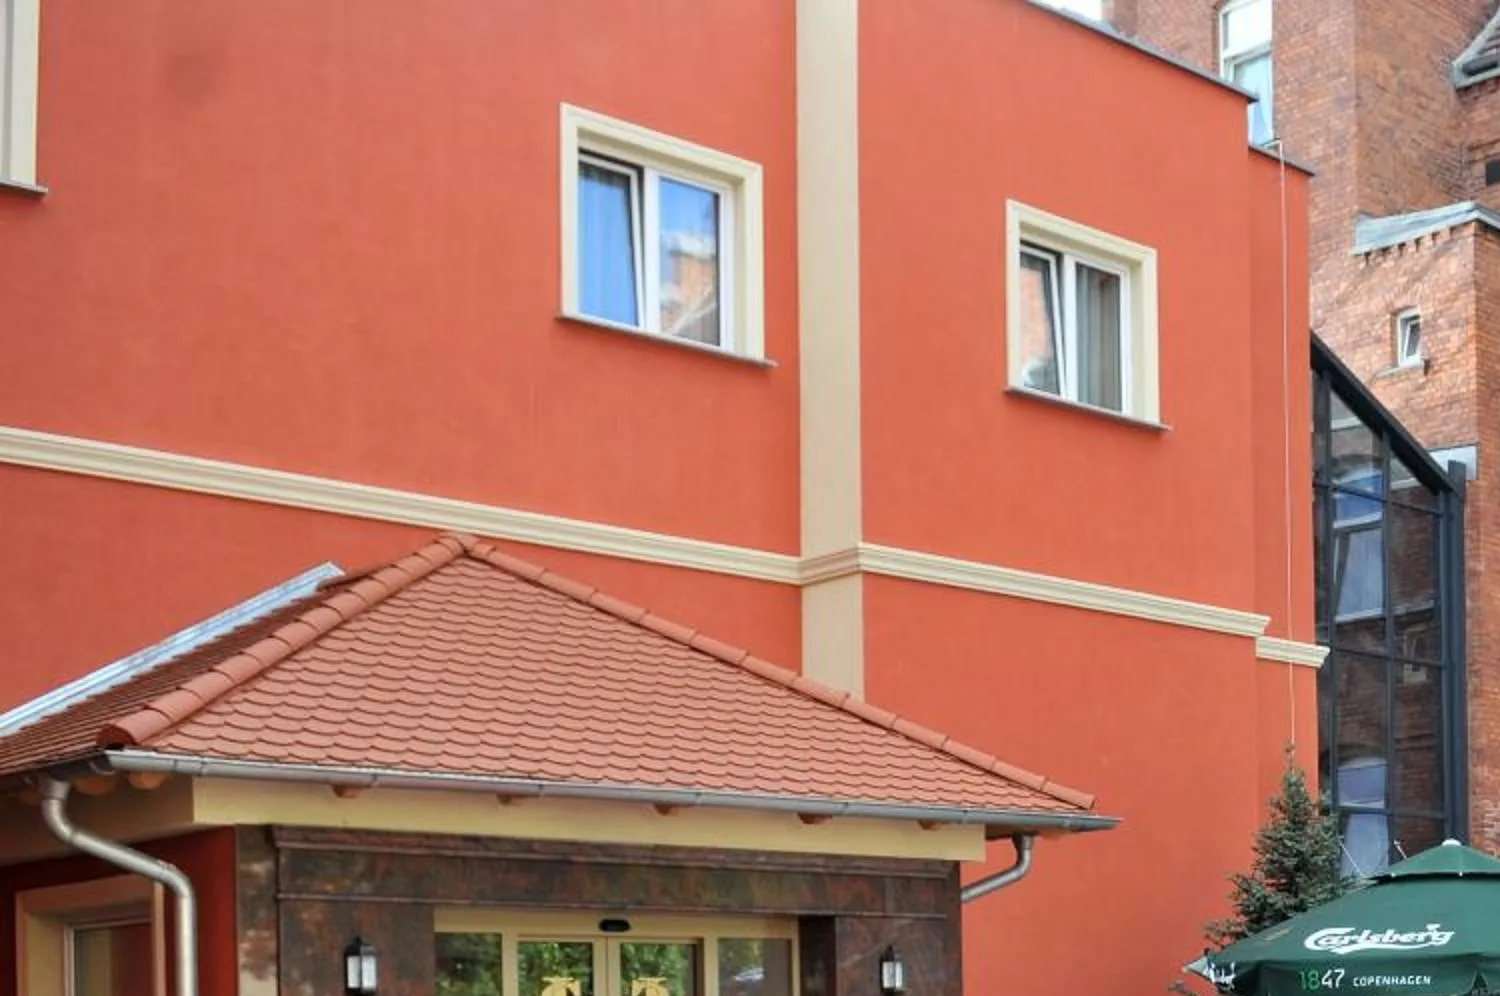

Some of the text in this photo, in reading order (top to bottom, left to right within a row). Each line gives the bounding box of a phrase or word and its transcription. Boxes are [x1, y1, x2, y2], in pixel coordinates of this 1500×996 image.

[1303, 923, 1455, 954] Carlsberg
[1298, 967, 1432, 990] 1847 COPENHAGEN
